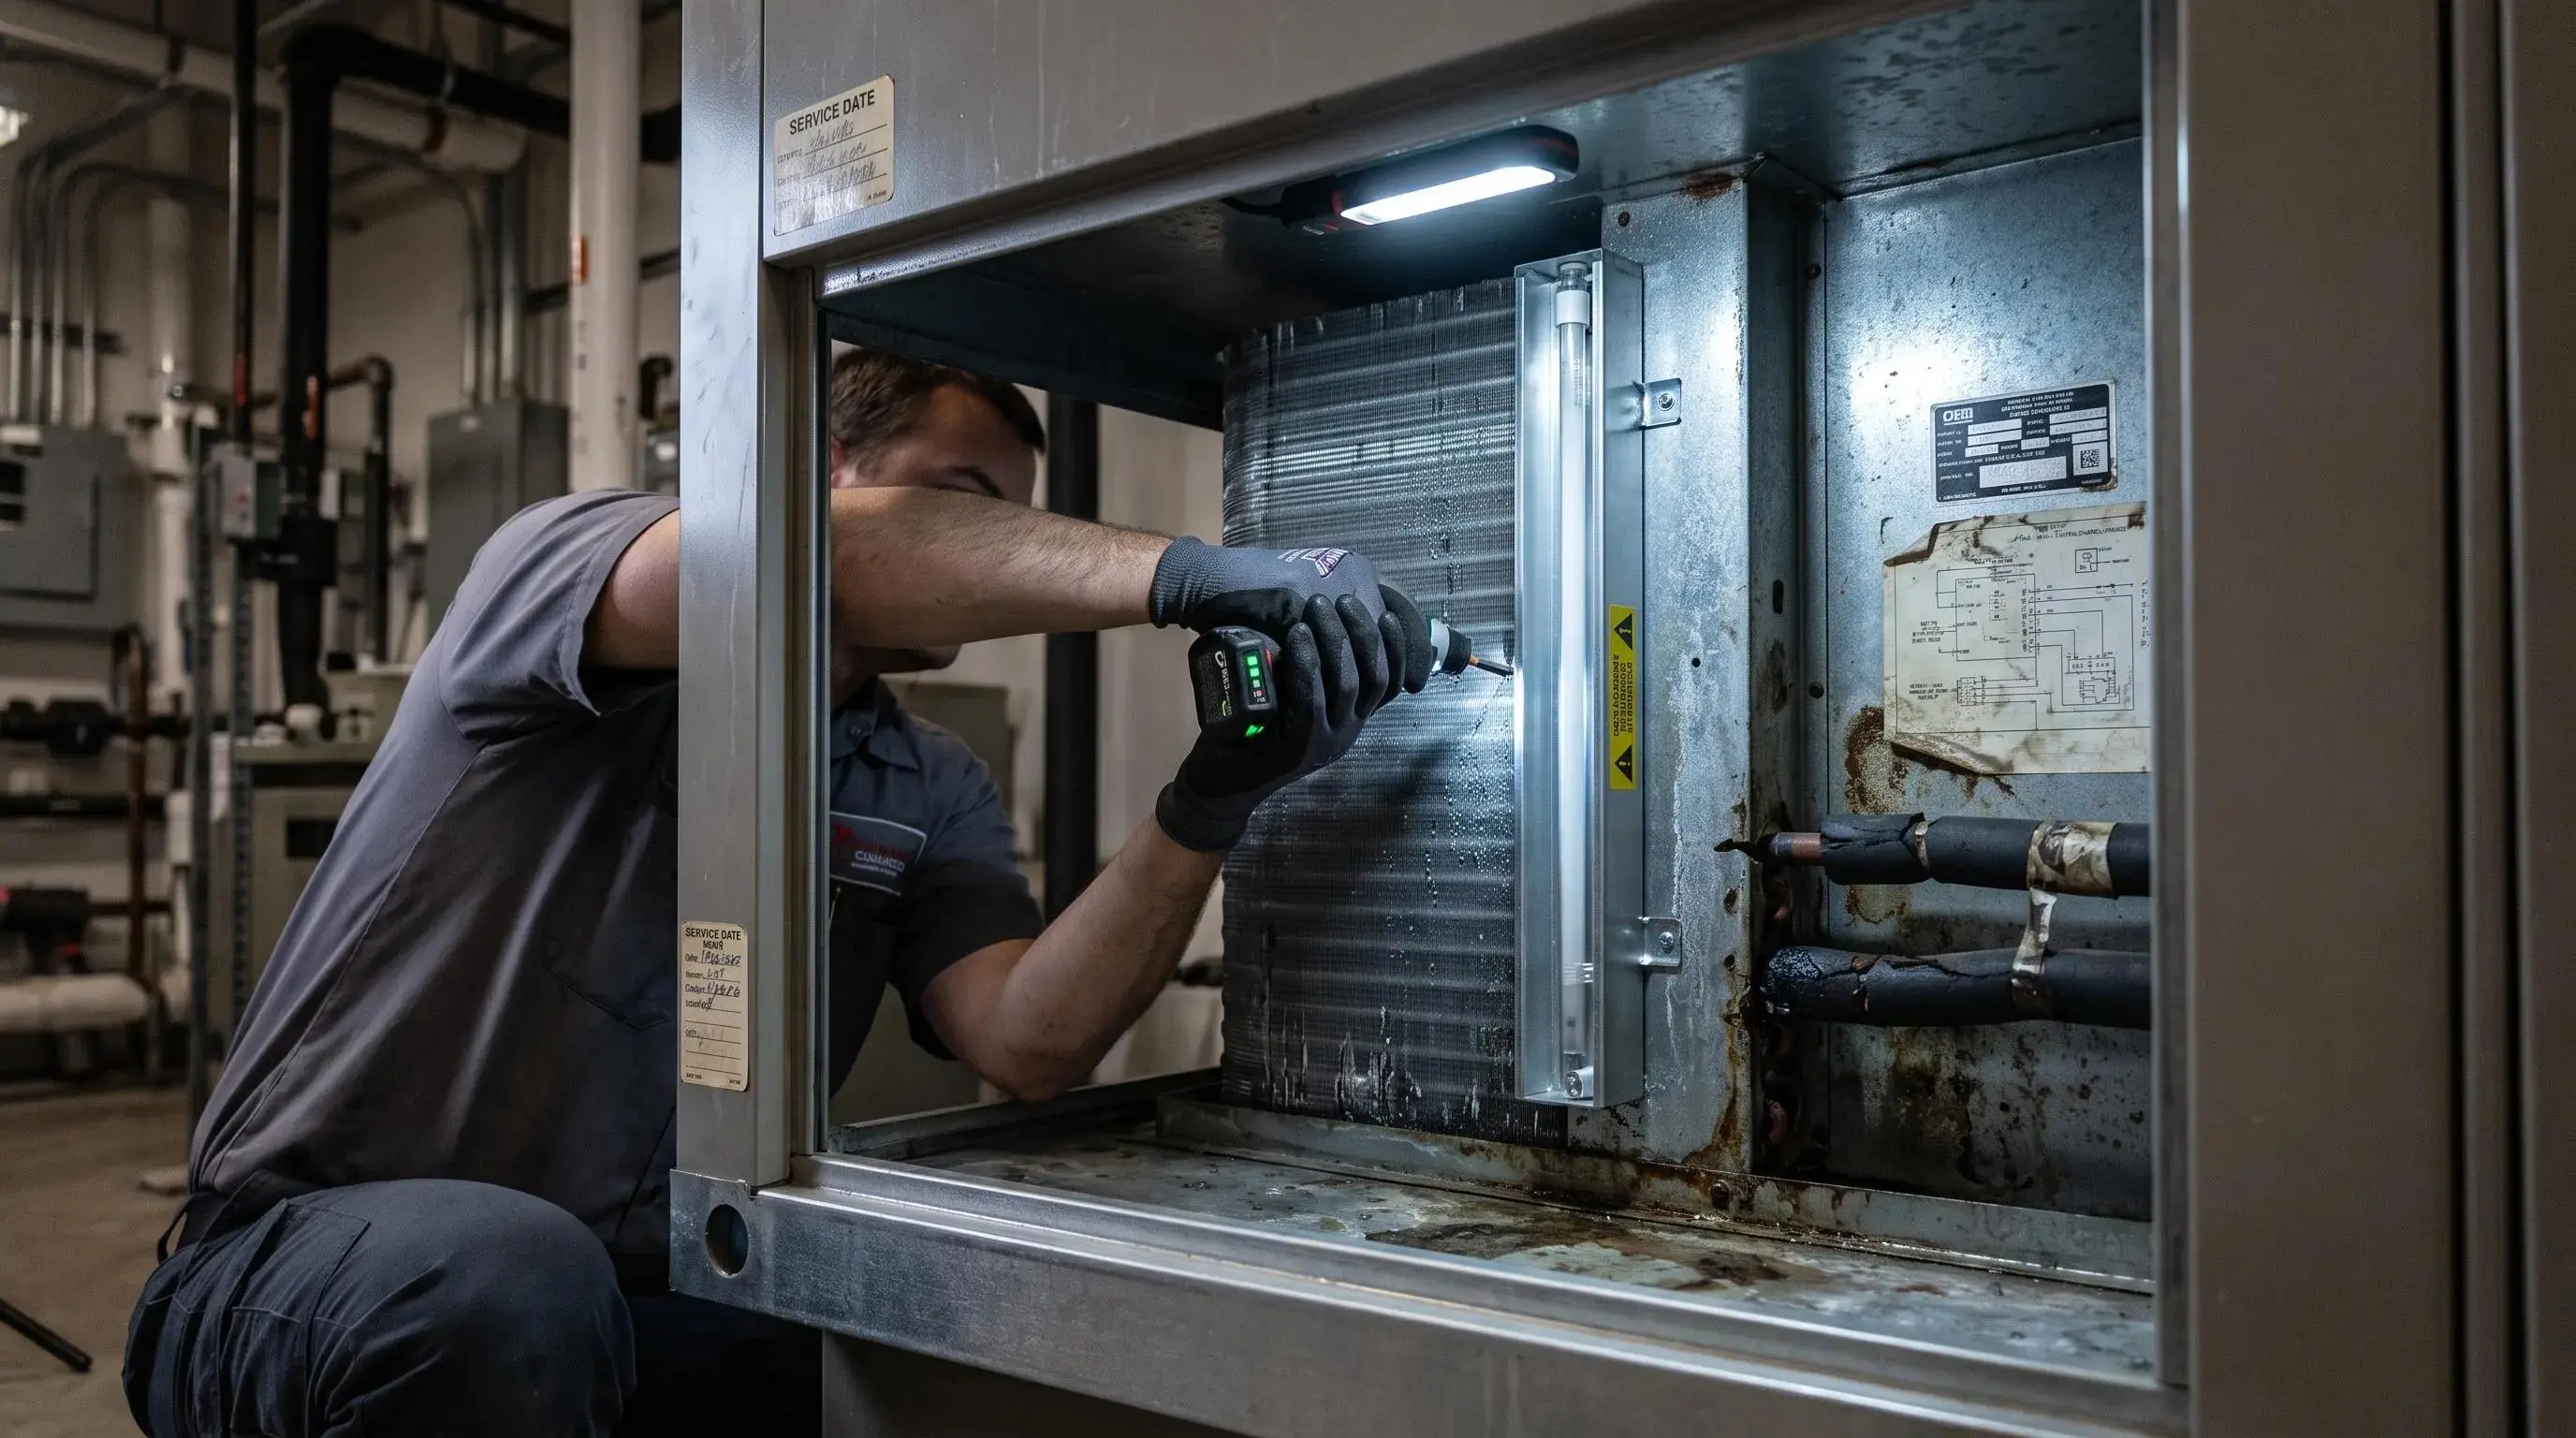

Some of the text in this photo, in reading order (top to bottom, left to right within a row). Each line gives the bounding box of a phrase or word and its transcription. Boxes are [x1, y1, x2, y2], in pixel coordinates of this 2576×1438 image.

[789, 102, 840, 135] SERVICE
[843, 89, 875, 116] DATE
[685, 927, 741, 941] SERVICE DATE
